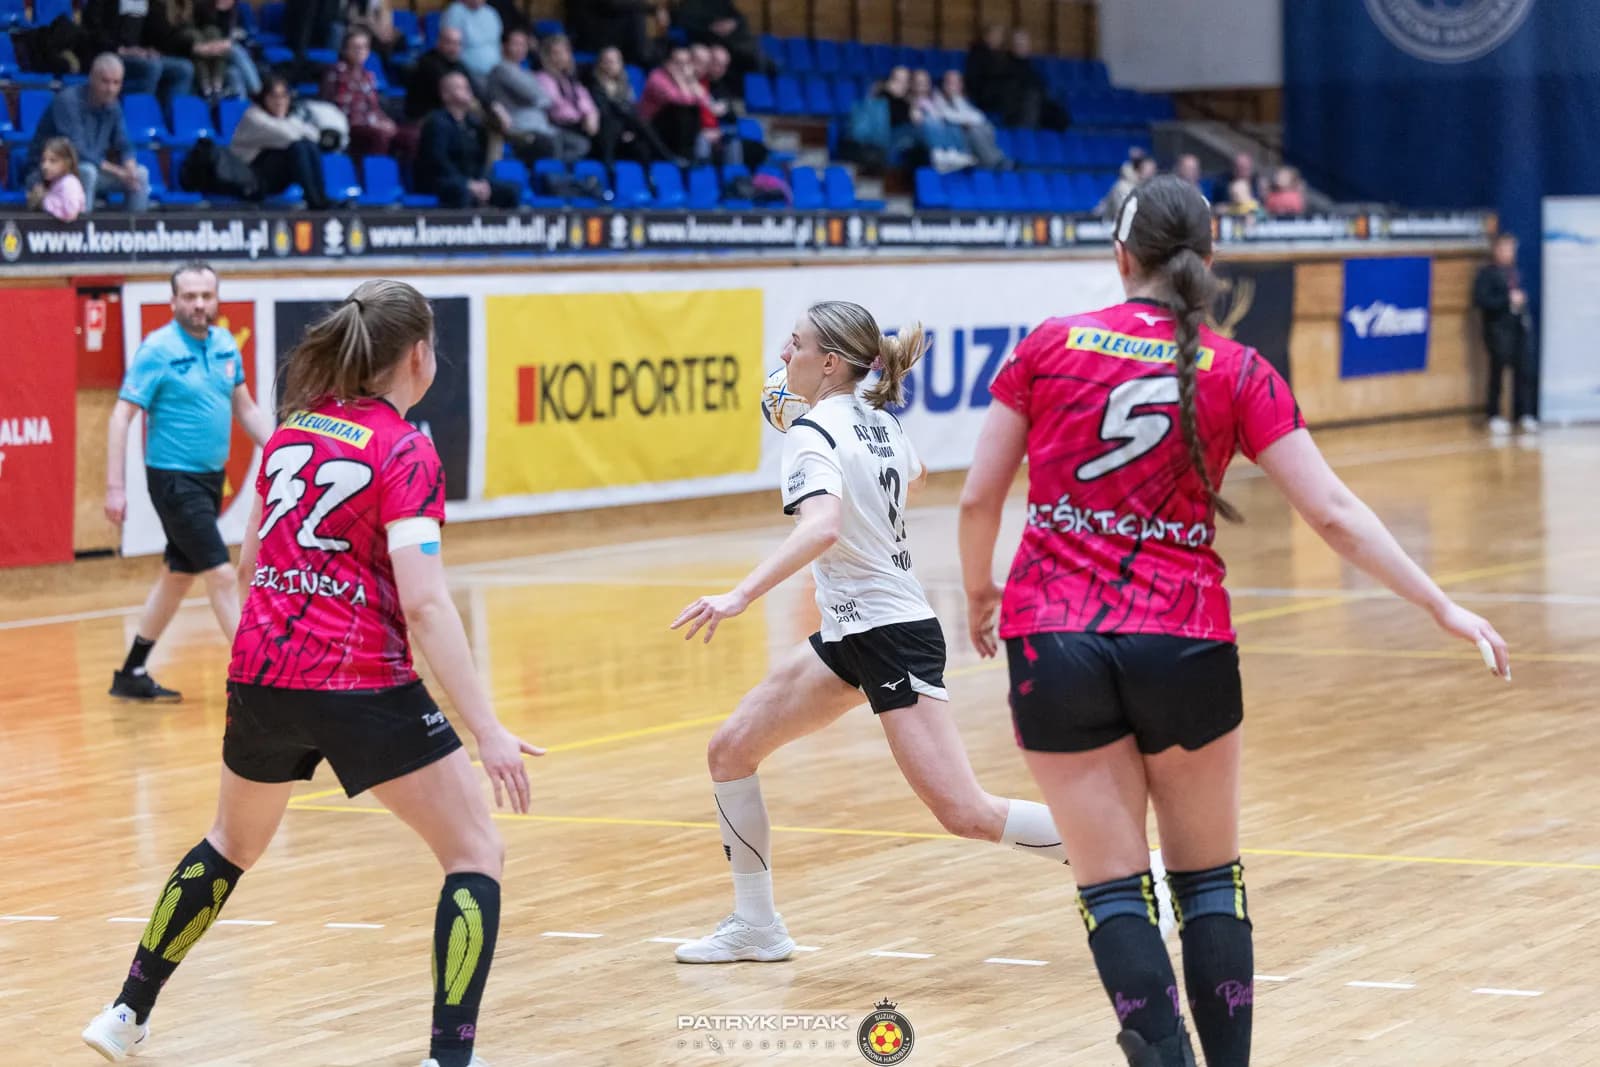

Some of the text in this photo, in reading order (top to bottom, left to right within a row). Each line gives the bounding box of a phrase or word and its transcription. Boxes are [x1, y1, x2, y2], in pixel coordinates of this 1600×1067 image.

[28, 219, 269, 259] www.koronahandball.pl
[540, 355, 740, 422] KOLPORTER
[879, 325, 1028, 415] UZ
[0, 416, 53, 446] ALNA
[1073, 375, 1182, 483] 5
[257, 442, 374, 552] 32
[830, 599, 857, 615] Yogi
[836, 610, 862, 623] 2011
